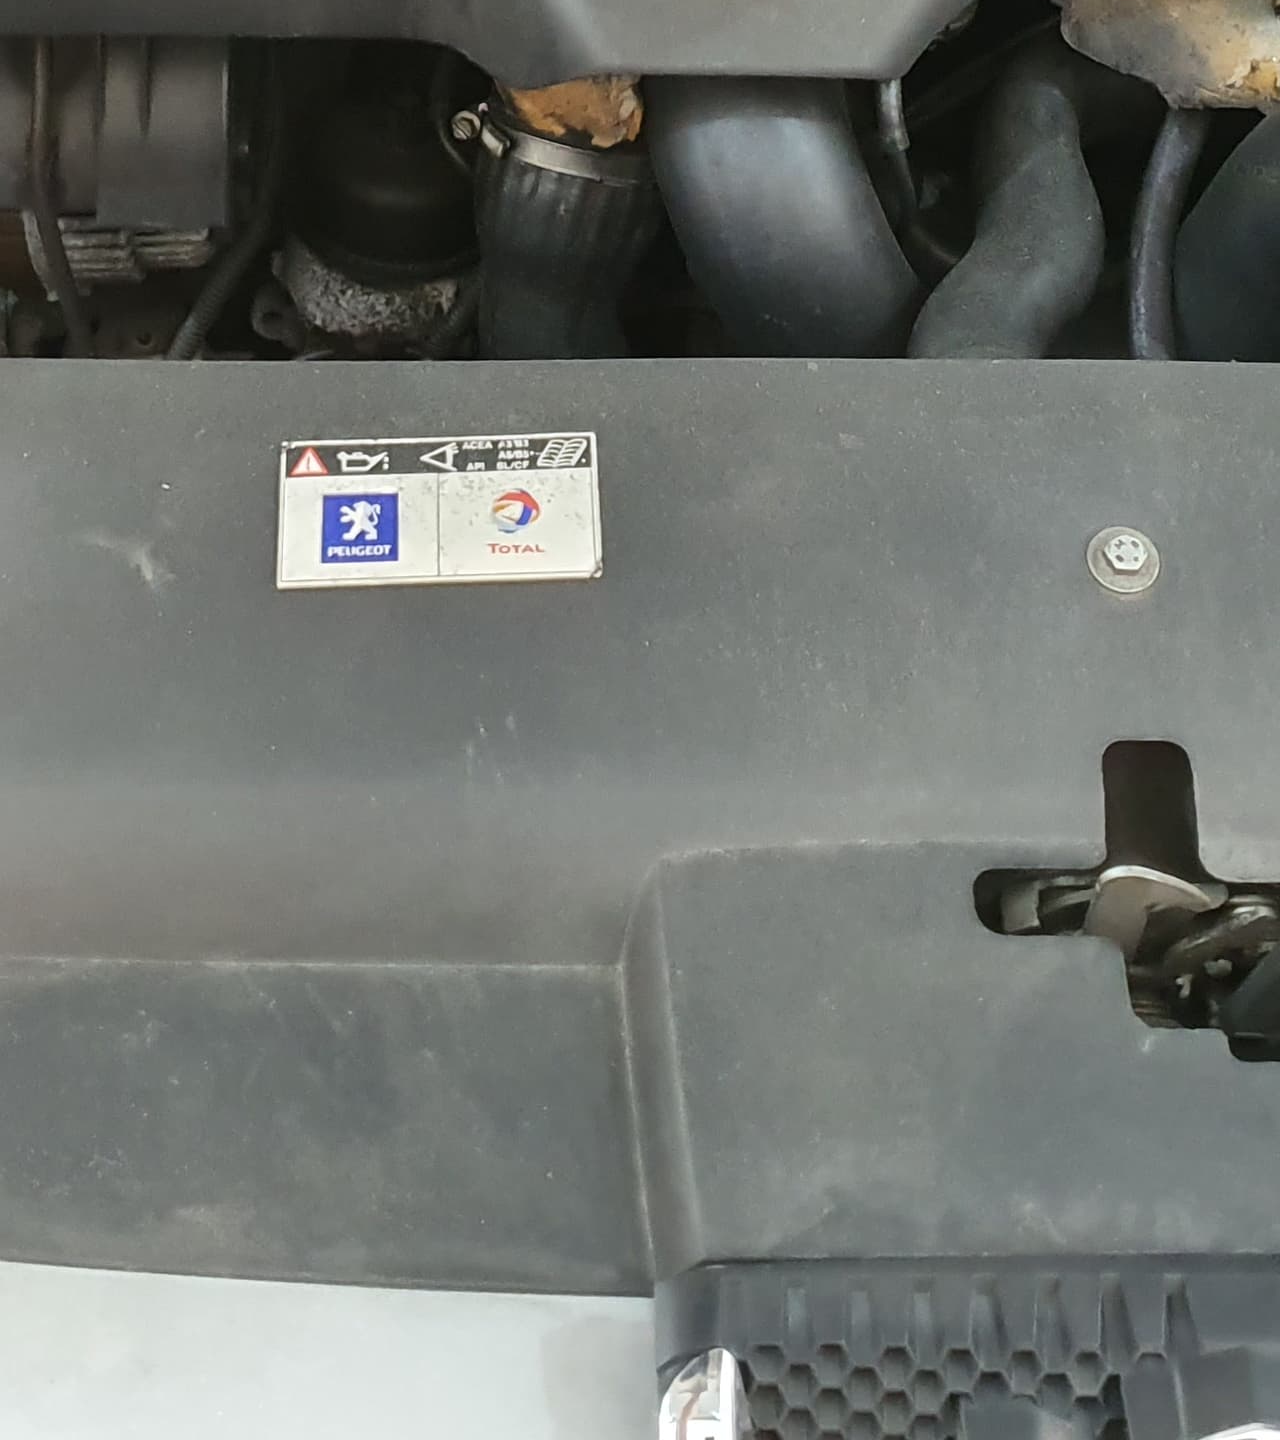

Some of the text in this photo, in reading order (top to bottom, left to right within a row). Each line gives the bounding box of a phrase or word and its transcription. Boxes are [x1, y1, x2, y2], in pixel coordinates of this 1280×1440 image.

[462, 441, 493, 450] ACEA
[466, 462, 485, 471] API
[327, 544, 392, 557] PEUGEOT
[488, 543, 545, 554] TOTAL
